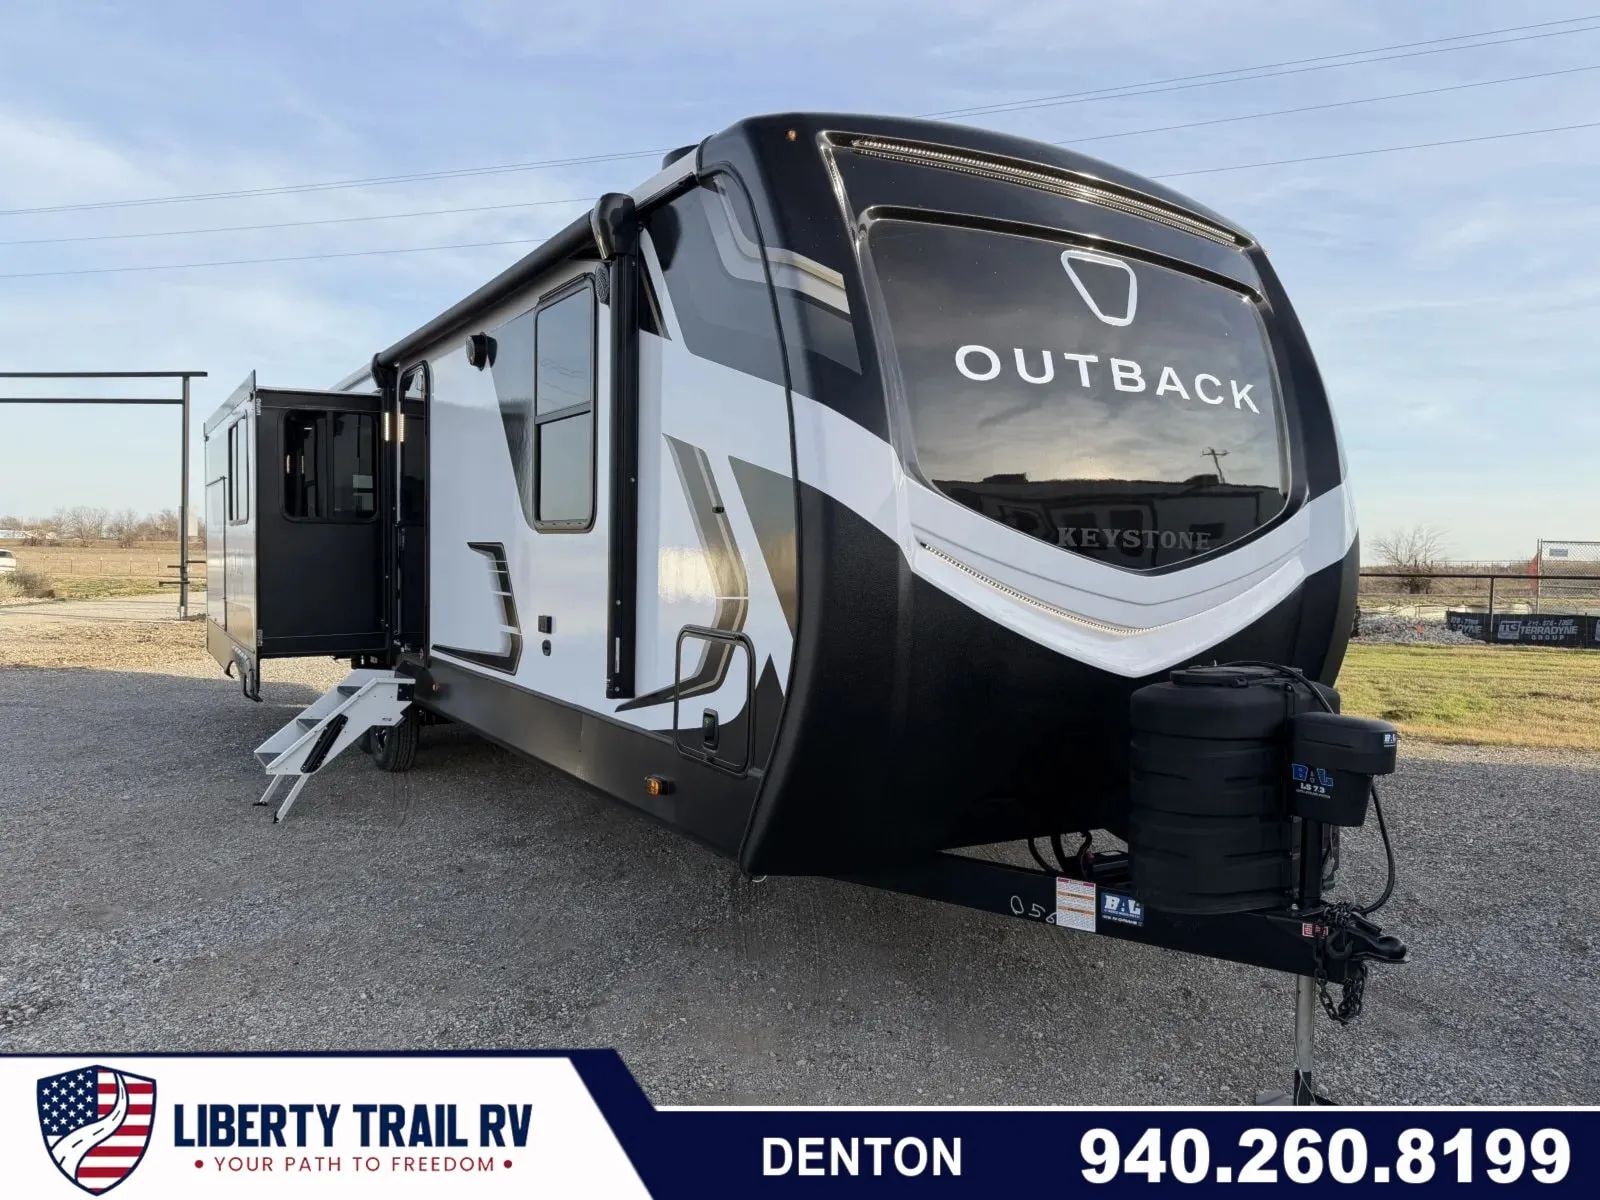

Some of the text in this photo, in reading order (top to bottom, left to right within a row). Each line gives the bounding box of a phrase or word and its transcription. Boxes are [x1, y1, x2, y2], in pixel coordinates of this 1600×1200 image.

[954, 344, 1261, 414] OUTBACK
[1057, 527, 1211, 550] KEYSTONE
[1520, 626, 1578, 634] TERRADYNE
[1104, 895, 1141, 915] BAL
